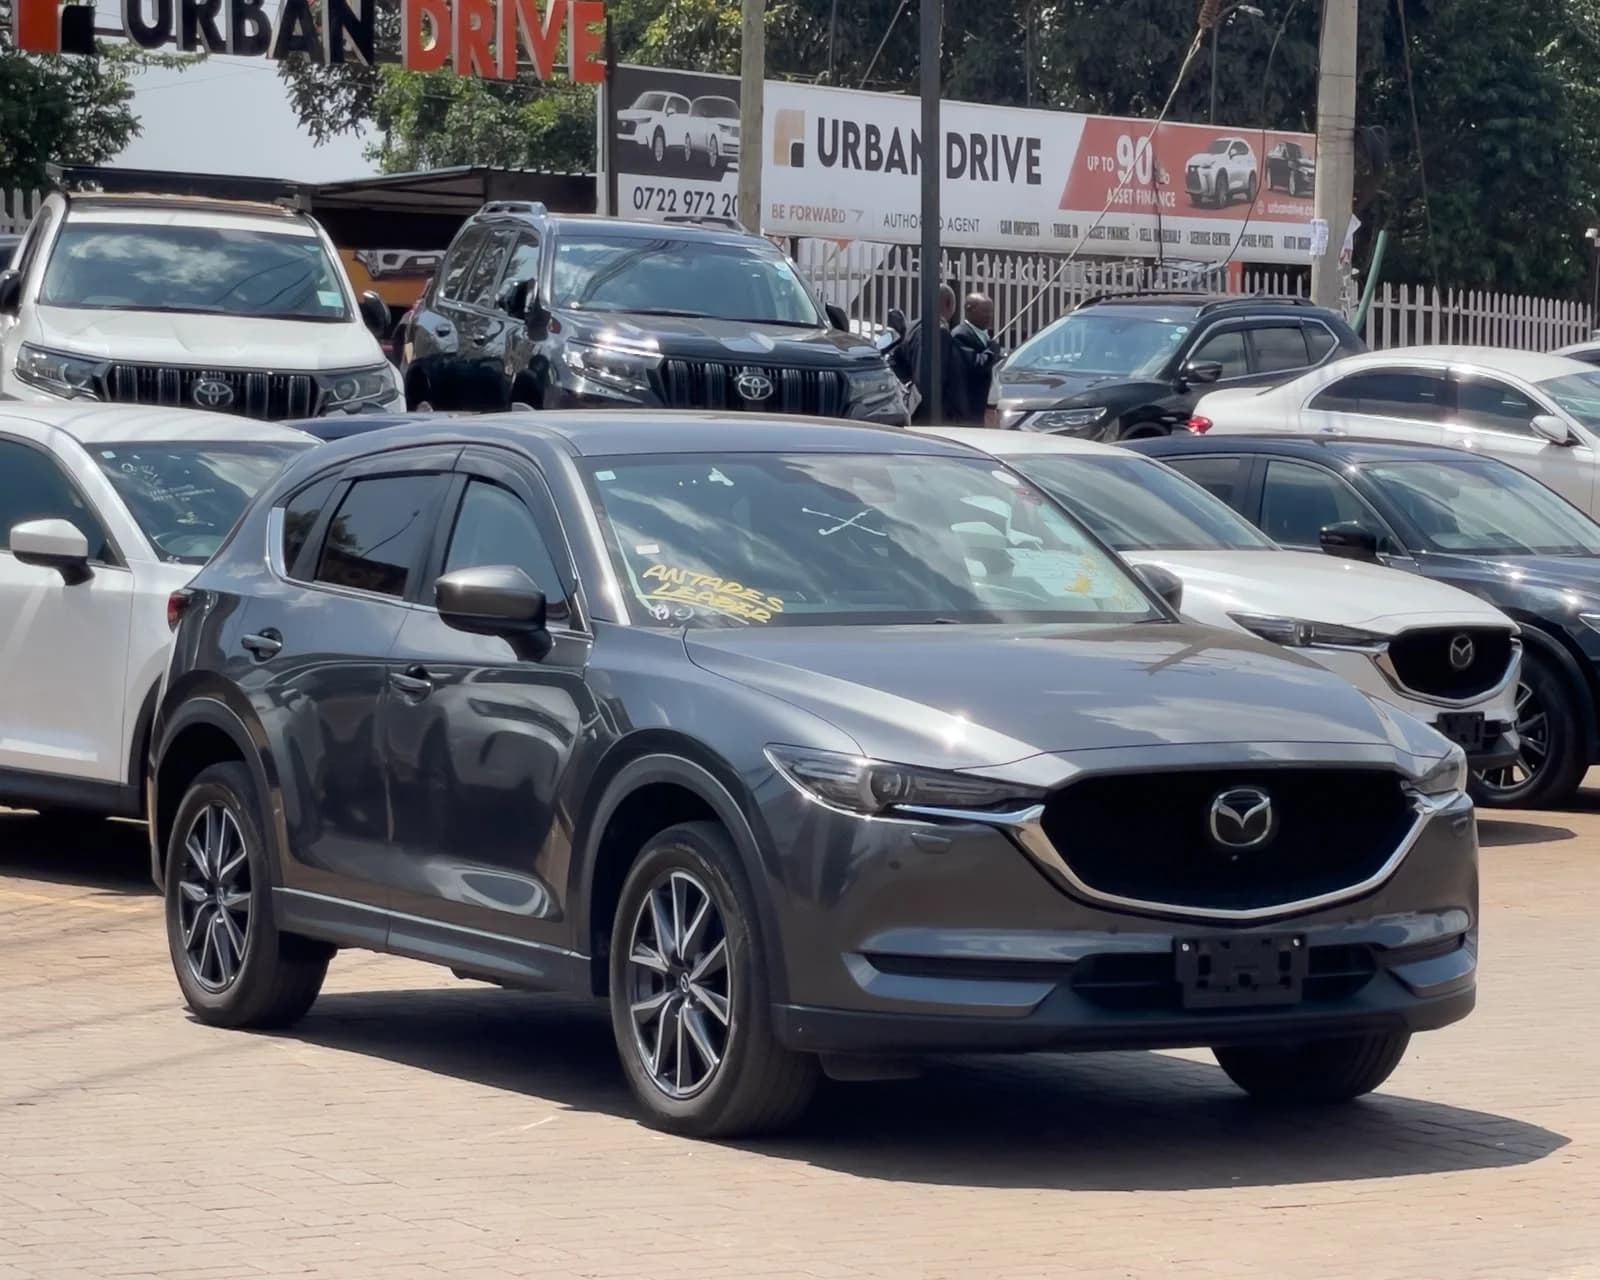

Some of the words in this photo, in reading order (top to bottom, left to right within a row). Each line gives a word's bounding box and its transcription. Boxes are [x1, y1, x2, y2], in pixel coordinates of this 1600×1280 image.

[122, 0, 374, 65] URBAN
[402, 0, 606, 82] DRIVE
[946, 131, 1042, 185] DRIVE
[1087, 155, 1099, 171] UP
[1101, 156, 1114, 173] TO
[633, 186, 677, 213] 0722
[683, 190, 715, 216] 972
[1106, 187, 1133, 205] ASSET
[1136, 188, 1176, 208] FINANCE
[771, 203, 785, 219] BE
[789, 205, 846, 223] FORWARD
[884, 213, 945, 231] AUTHOD
[947, 217, 980, 233] AGENT
